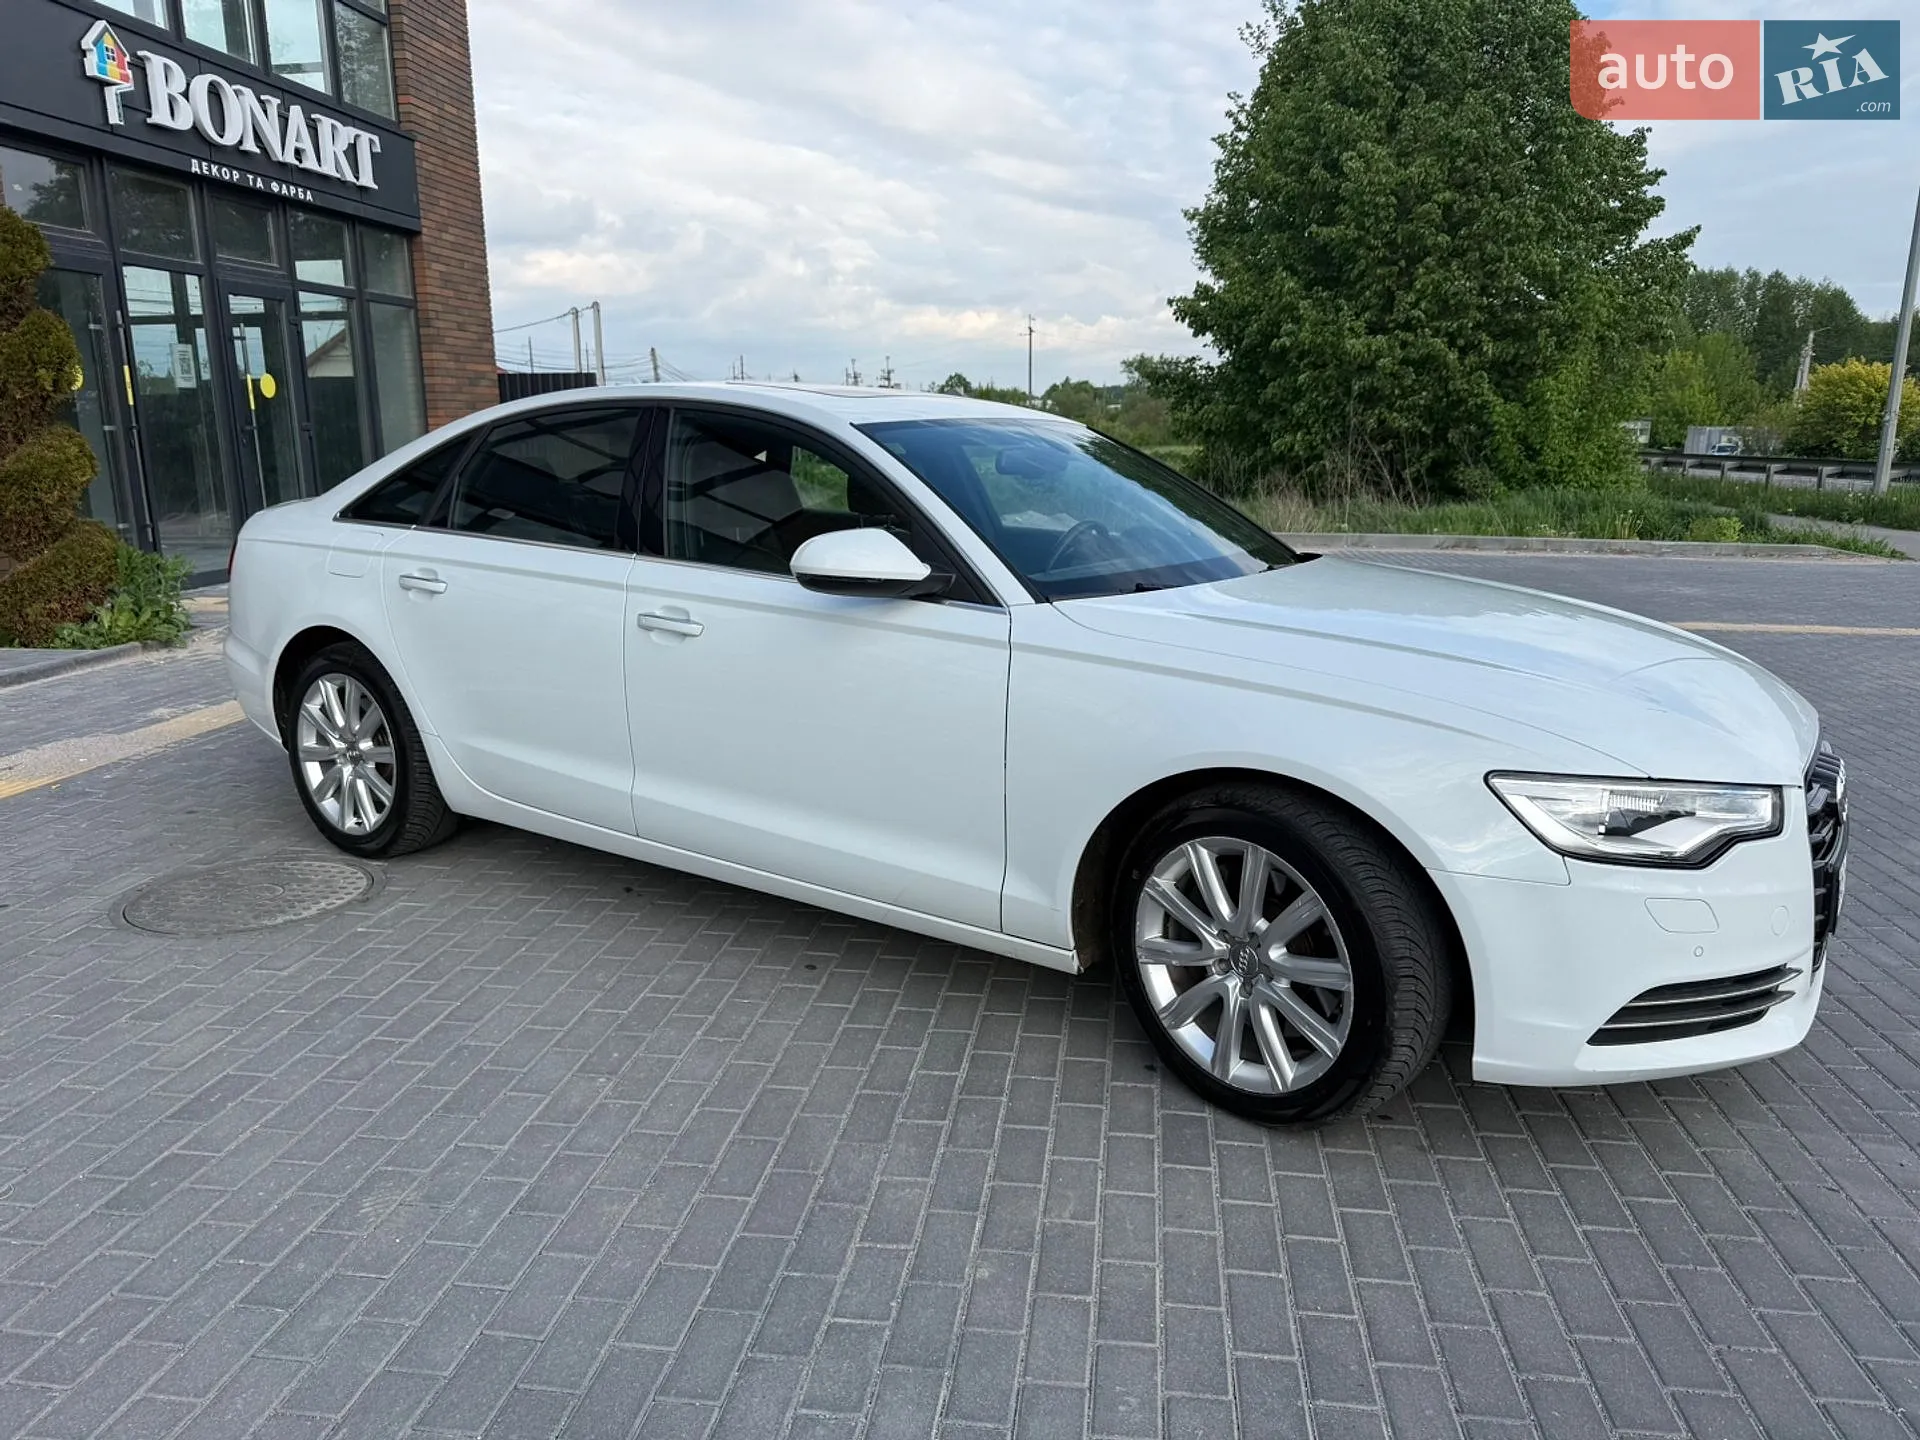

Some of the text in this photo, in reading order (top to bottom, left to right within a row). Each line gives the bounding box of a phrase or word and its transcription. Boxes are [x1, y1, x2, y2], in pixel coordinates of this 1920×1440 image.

[136, 50, 381, 190] BONART
[191, 158, 314, 202] ДЕКОР ТА ФАРБА
